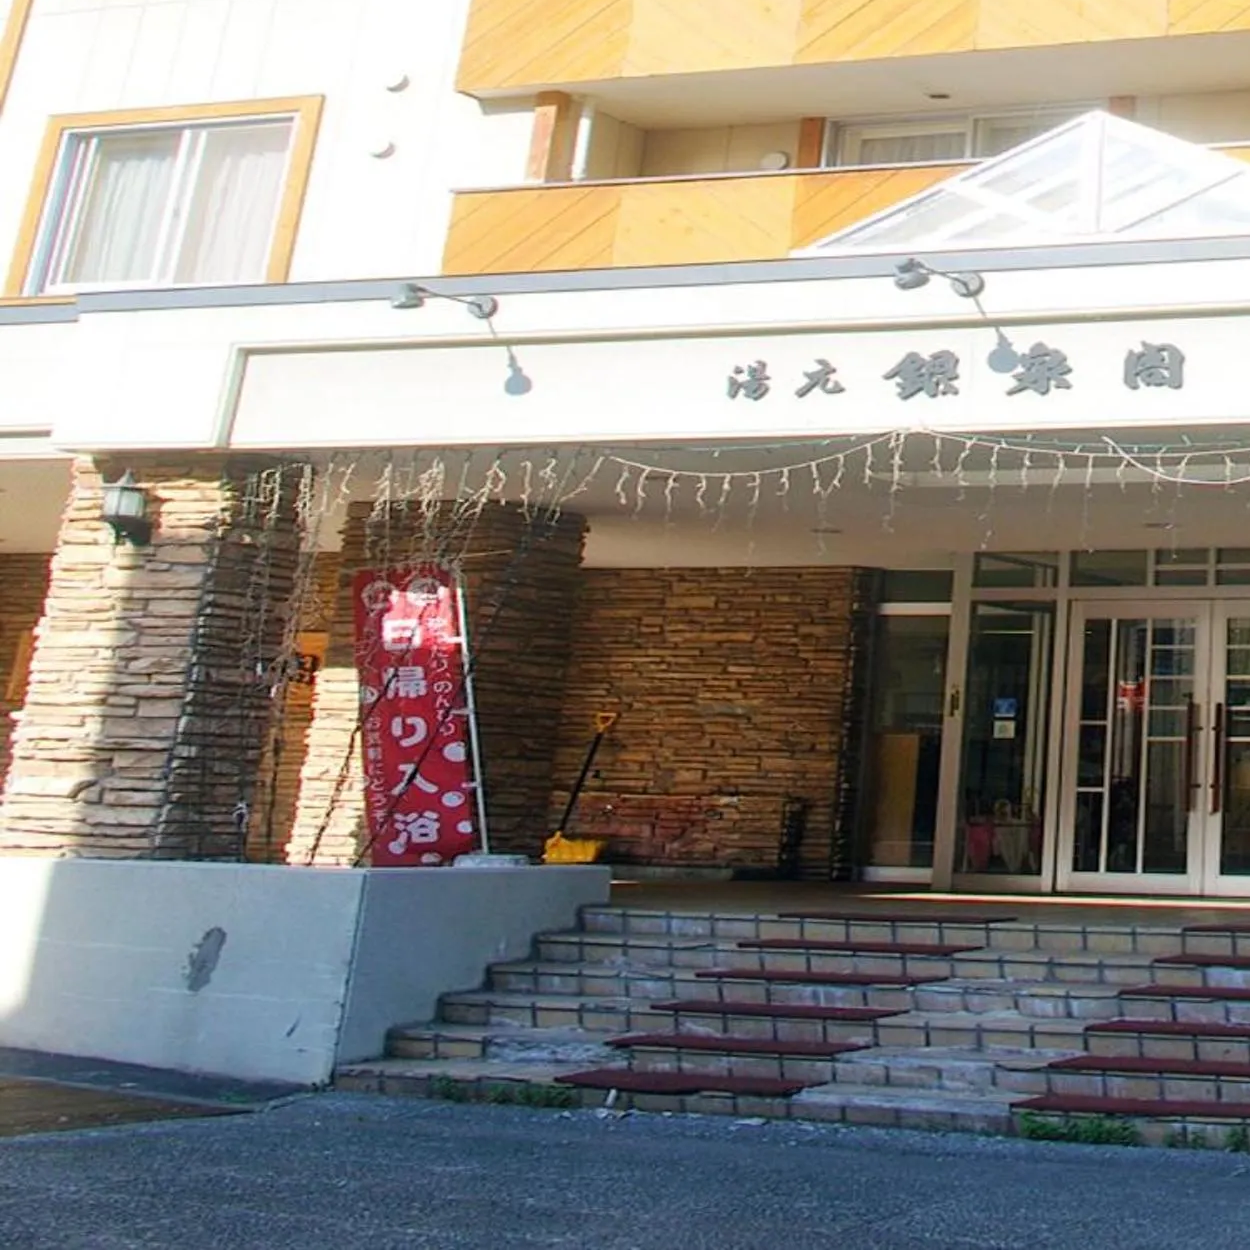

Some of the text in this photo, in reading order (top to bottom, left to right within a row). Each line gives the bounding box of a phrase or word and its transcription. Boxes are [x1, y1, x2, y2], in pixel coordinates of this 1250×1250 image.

[382, 618, 440, 843] 日帰り入浴
